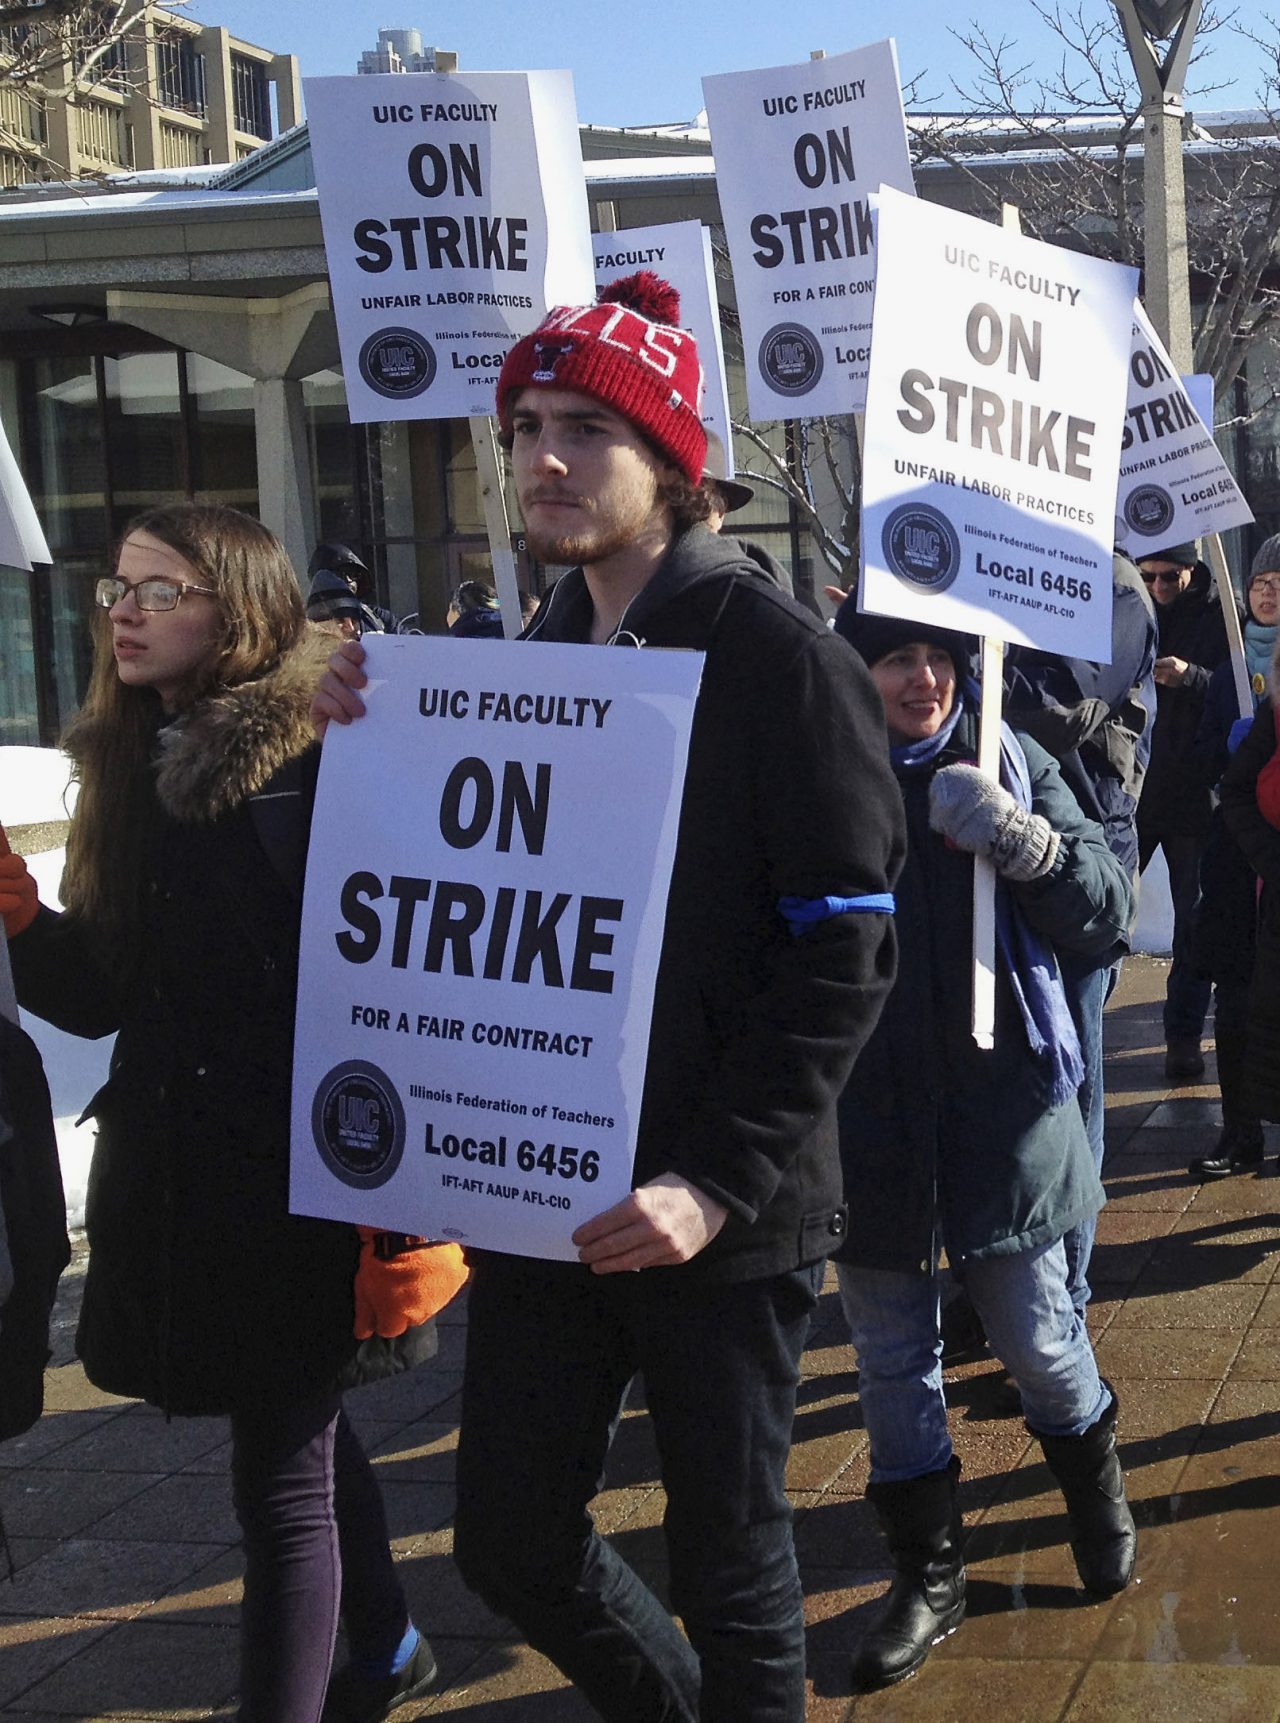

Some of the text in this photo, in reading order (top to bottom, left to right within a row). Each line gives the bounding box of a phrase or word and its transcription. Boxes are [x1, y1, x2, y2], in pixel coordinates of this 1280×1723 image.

[373, 103, 498, 124] UIC FACULTY
[763, 79, 866, 117] UIC FACULTY
[408, 143, 482, 198] ON
[794, 126, 856, 189] ON
[354, 216, 528, 273] STRIKE
[750, 200, 875, 269] STRIK
[595, 247, 666, 268] FACULTY
[944, 244, 1081, 307] UIC FACULTY
[361, 292, 533, 309] UNFAIR LABOR PRACTICES
[774, 290, 801, 304] FOR
[806, 288, 815, 301] A
[819, 284, 846, 300] FAIR
[435, 332, 470, 340] Illinois
[850, 323, 873, 332] Federa
[966, 302, 1042, 382] ON
[379, 347, 415, 367] UIC
[835, 346, 871, 364] Loca
[1131, 345, 1172, 388] ON
[897, 368, 1095, 482] STRIKE
[1119, 447, 1190, 477] UNFAIR LABOR
[894, 458, 1095, 525] UNFAIR LABOR PRACTICES
[1181, 483, 1218, 506] Local
[904, 525, 940, 556] UIC
[964, 524, 1098, 569] Illinois Federation of Teachers
[976, 553, 1092, 602] Local 6456
[988, 588, 1075, 618] IFT-AFT AAUP AFL-CIO
[418, 688, 612, 728] UIC FACULTY
[439, 756, 552, 857] ON
[335, 870, 625, 995] STRIKE
[351, 1005, 594, 1058] FOR A FAIR CONTRACT
[339, 1095, 380, 1133] UIC
[409, 1084, 615, 1128] Illinois Federation of Teachers
[425, 1123, 600, 1183] Local 6456
[441, 1174, 571, 1210] IFT-AFT AAUP AFL-CIO
